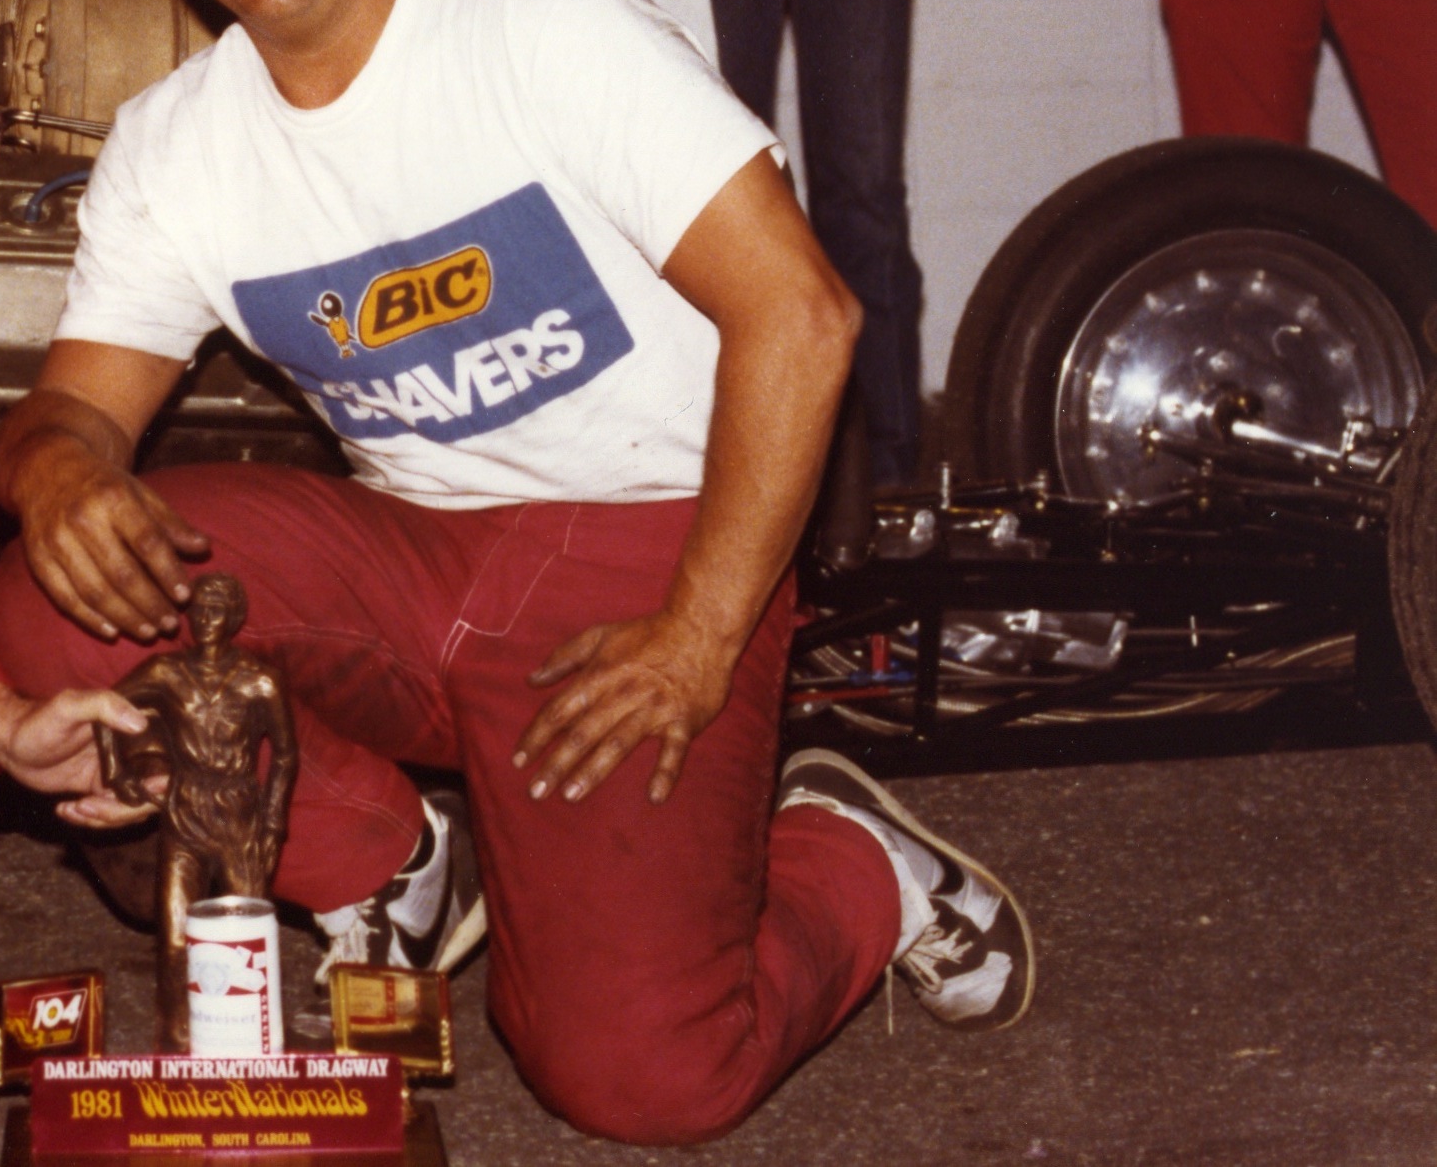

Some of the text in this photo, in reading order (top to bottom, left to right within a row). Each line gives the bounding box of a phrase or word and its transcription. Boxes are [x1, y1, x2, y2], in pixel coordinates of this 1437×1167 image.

[33, 994, 82, 1030] 104
[44, 1057, 390, 1080] DARLINGTON INTERNATIONAL DRAGWAY
[71, 1079, 368, 1118] 1981 WinterNationals
[212, 1133, 250, 1146] SOUTH
[256, 1132, 312, 1146] CAROLINA
